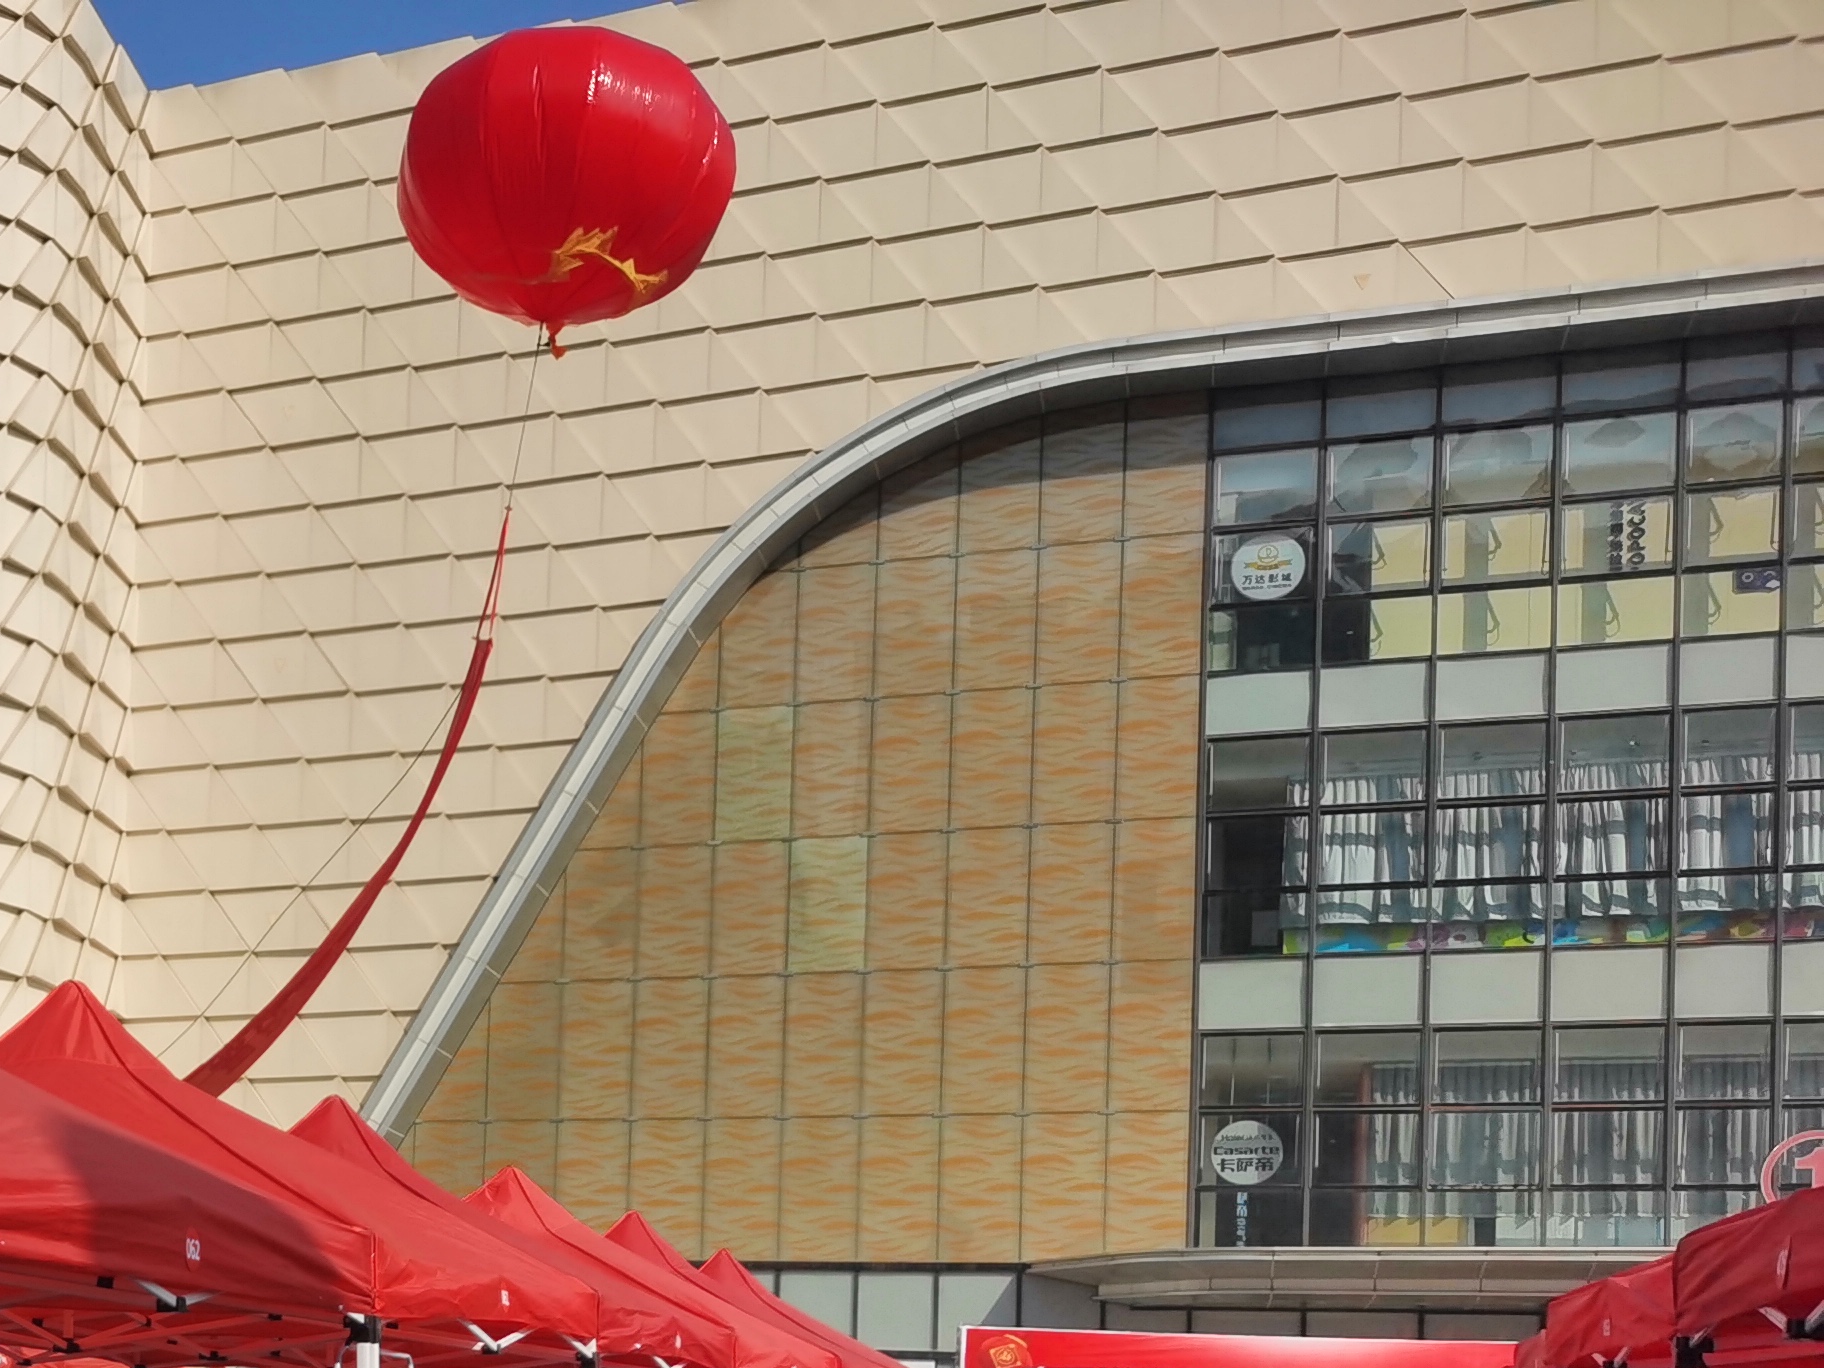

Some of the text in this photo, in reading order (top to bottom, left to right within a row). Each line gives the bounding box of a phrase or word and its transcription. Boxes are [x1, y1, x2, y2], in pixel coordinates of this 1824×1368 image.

[1213, 1145, 1280, 1156] Casarte
[1216, 1157, 1275, 1173] 卡萨帝
[186, 1238, 201, 1261] 062
